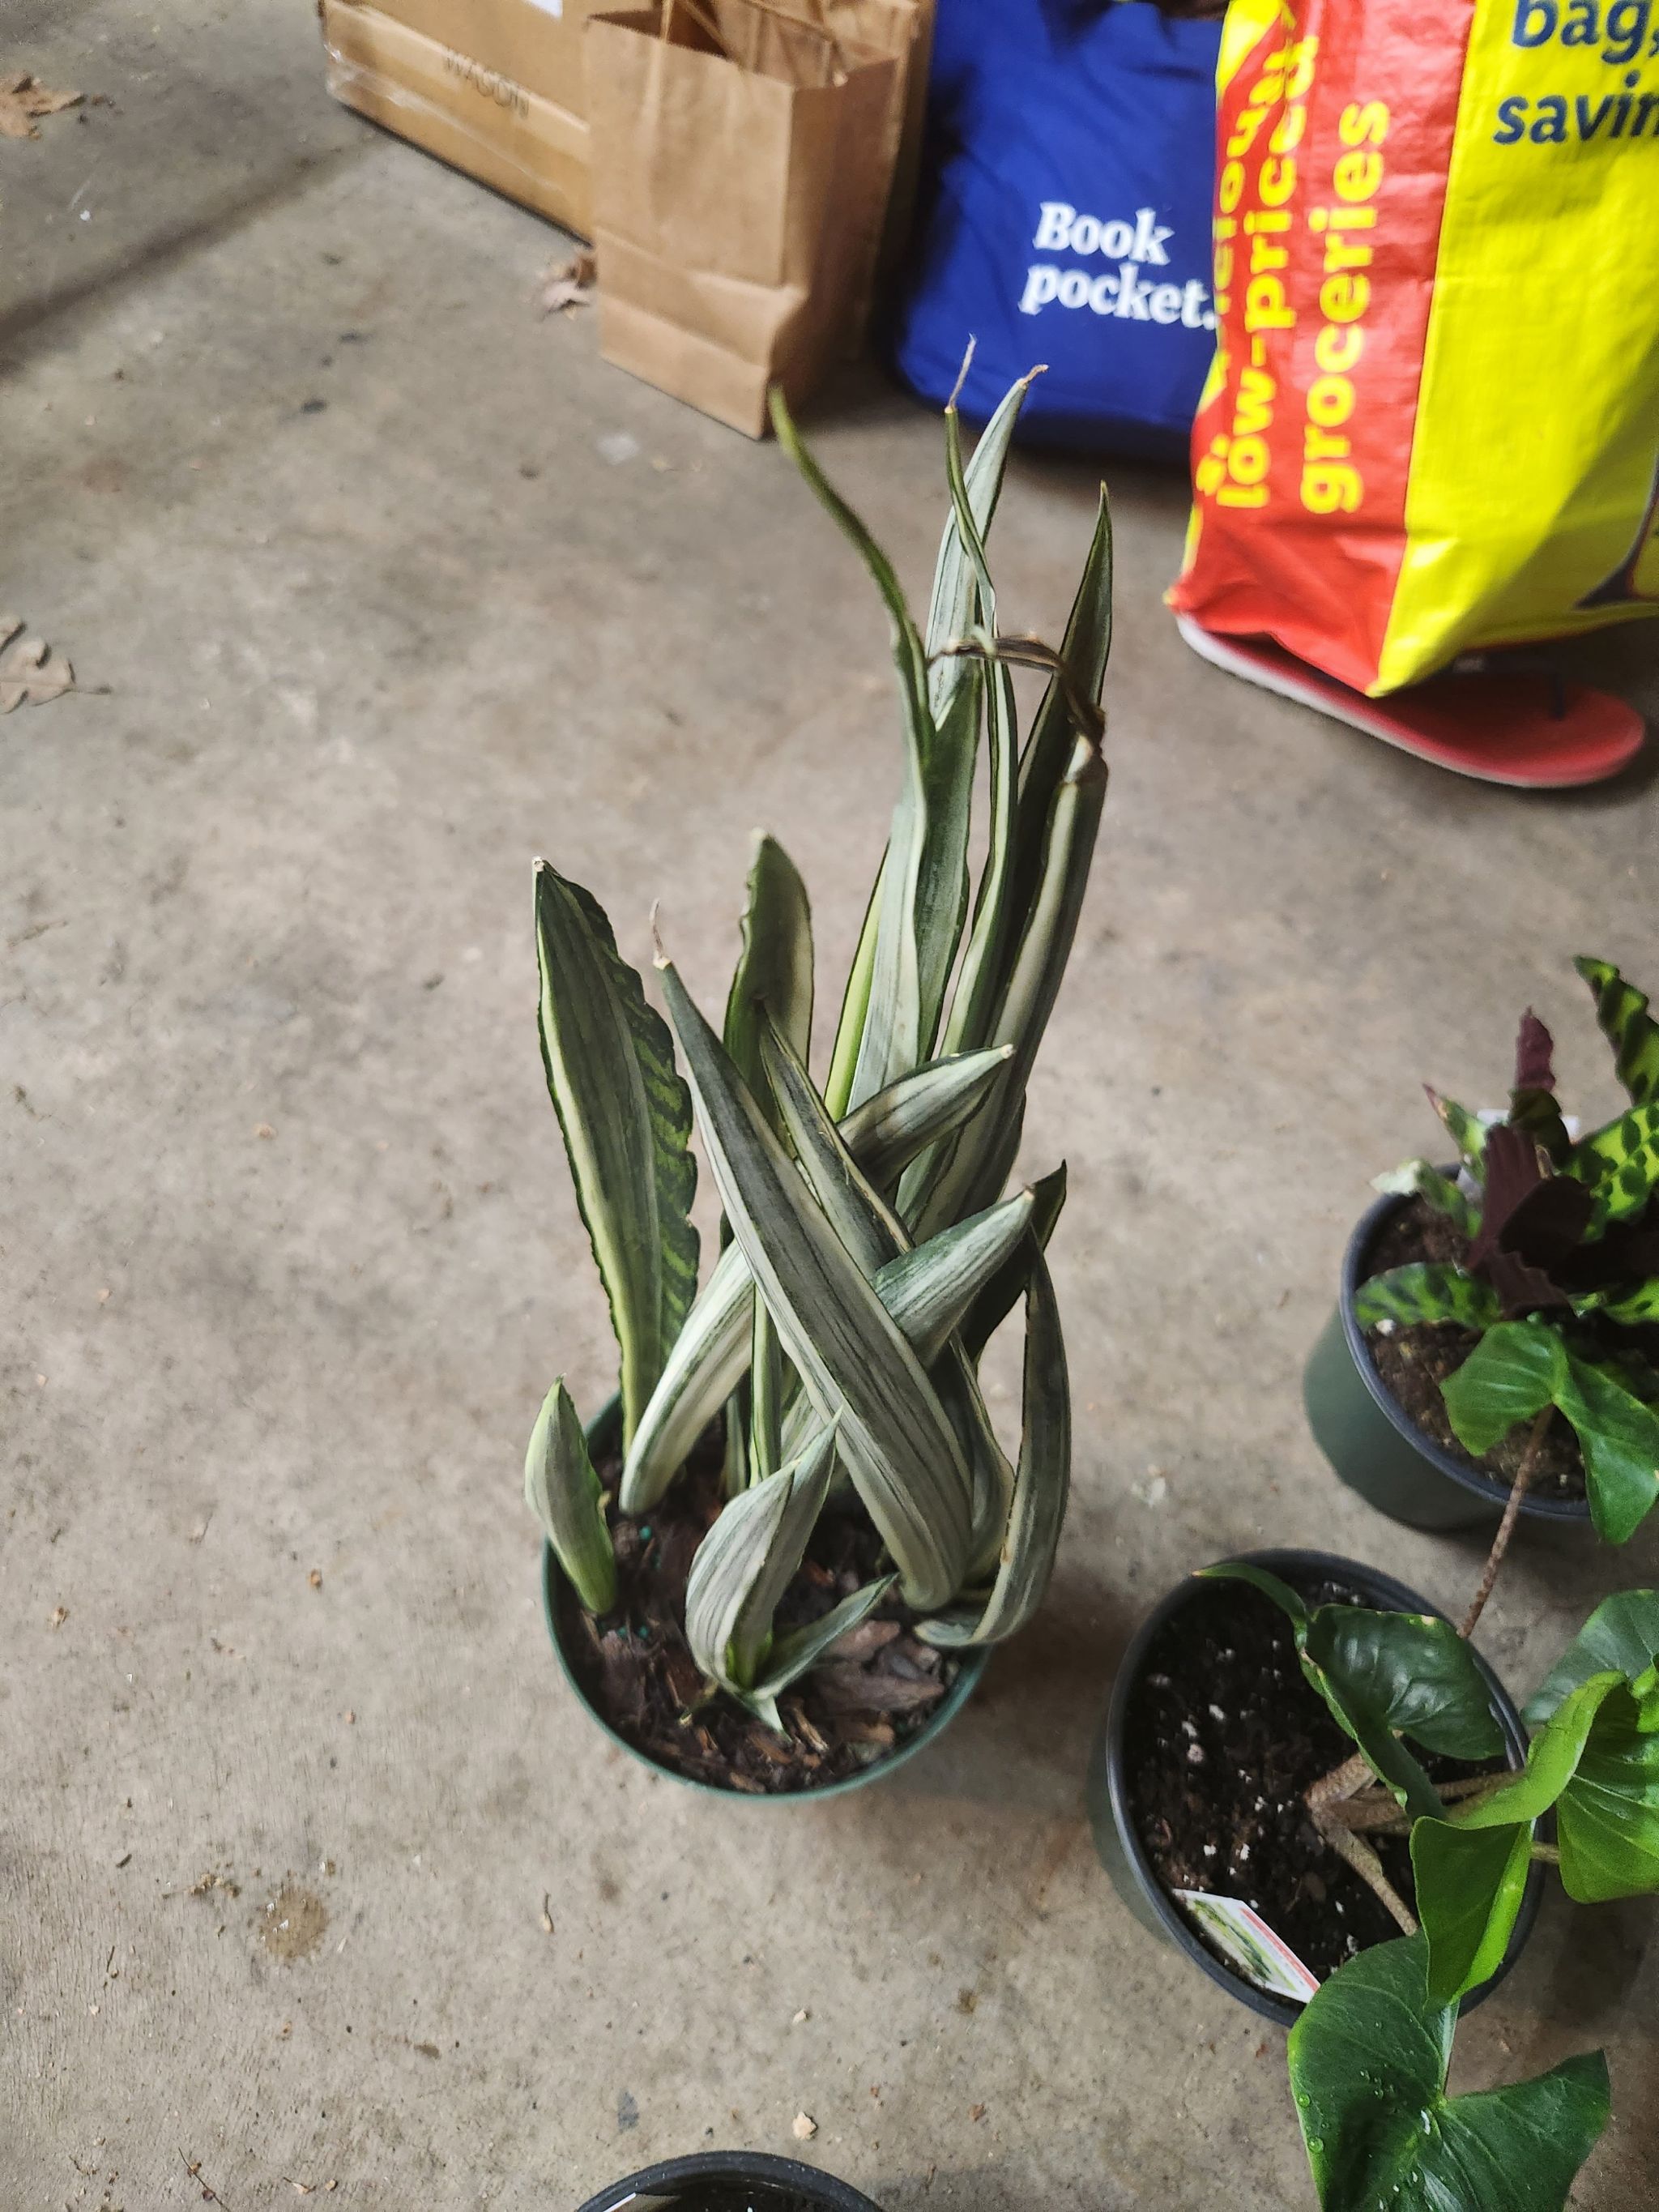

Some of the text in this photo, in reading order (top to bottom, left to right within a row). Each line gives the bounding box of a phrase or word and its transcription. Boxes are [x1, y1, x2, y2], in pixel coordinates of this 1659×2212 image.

[1033, 201, 1175, 266] Book
[1017, 262, 1220, 331] pocket.
[1300, 99, 1390, 515] groceries
